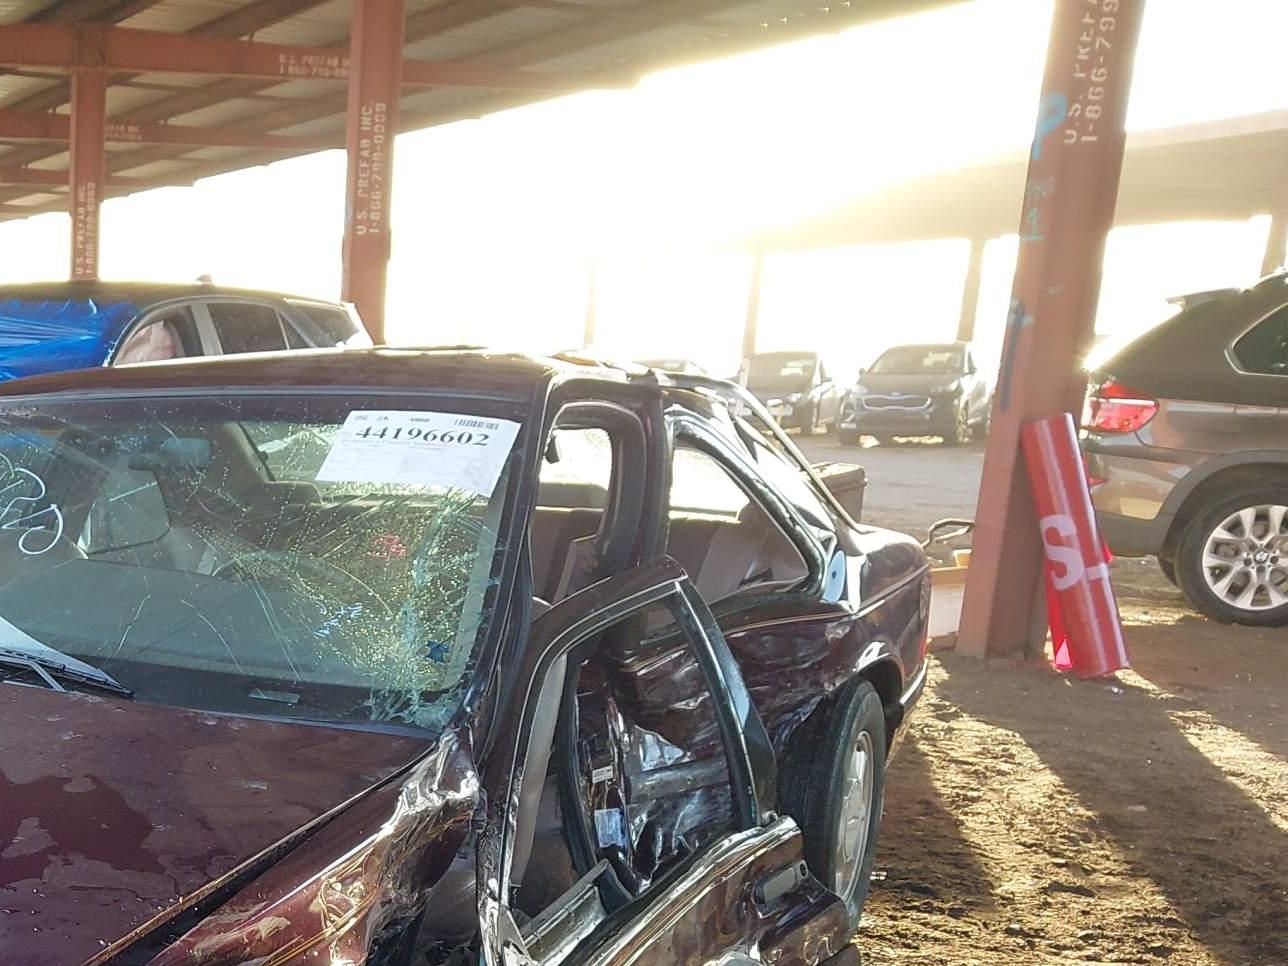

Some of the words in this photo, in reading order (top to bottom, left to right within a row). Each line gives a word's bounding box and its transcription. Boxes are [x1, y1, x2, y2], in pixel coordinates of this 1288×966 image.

[1064, 96, 1082, 144] U.S.
[1073, 0, 1099, 79] PREF
[357, 138, 372, 198] PREFAB
[355, 425, 490, 447] 44196602
